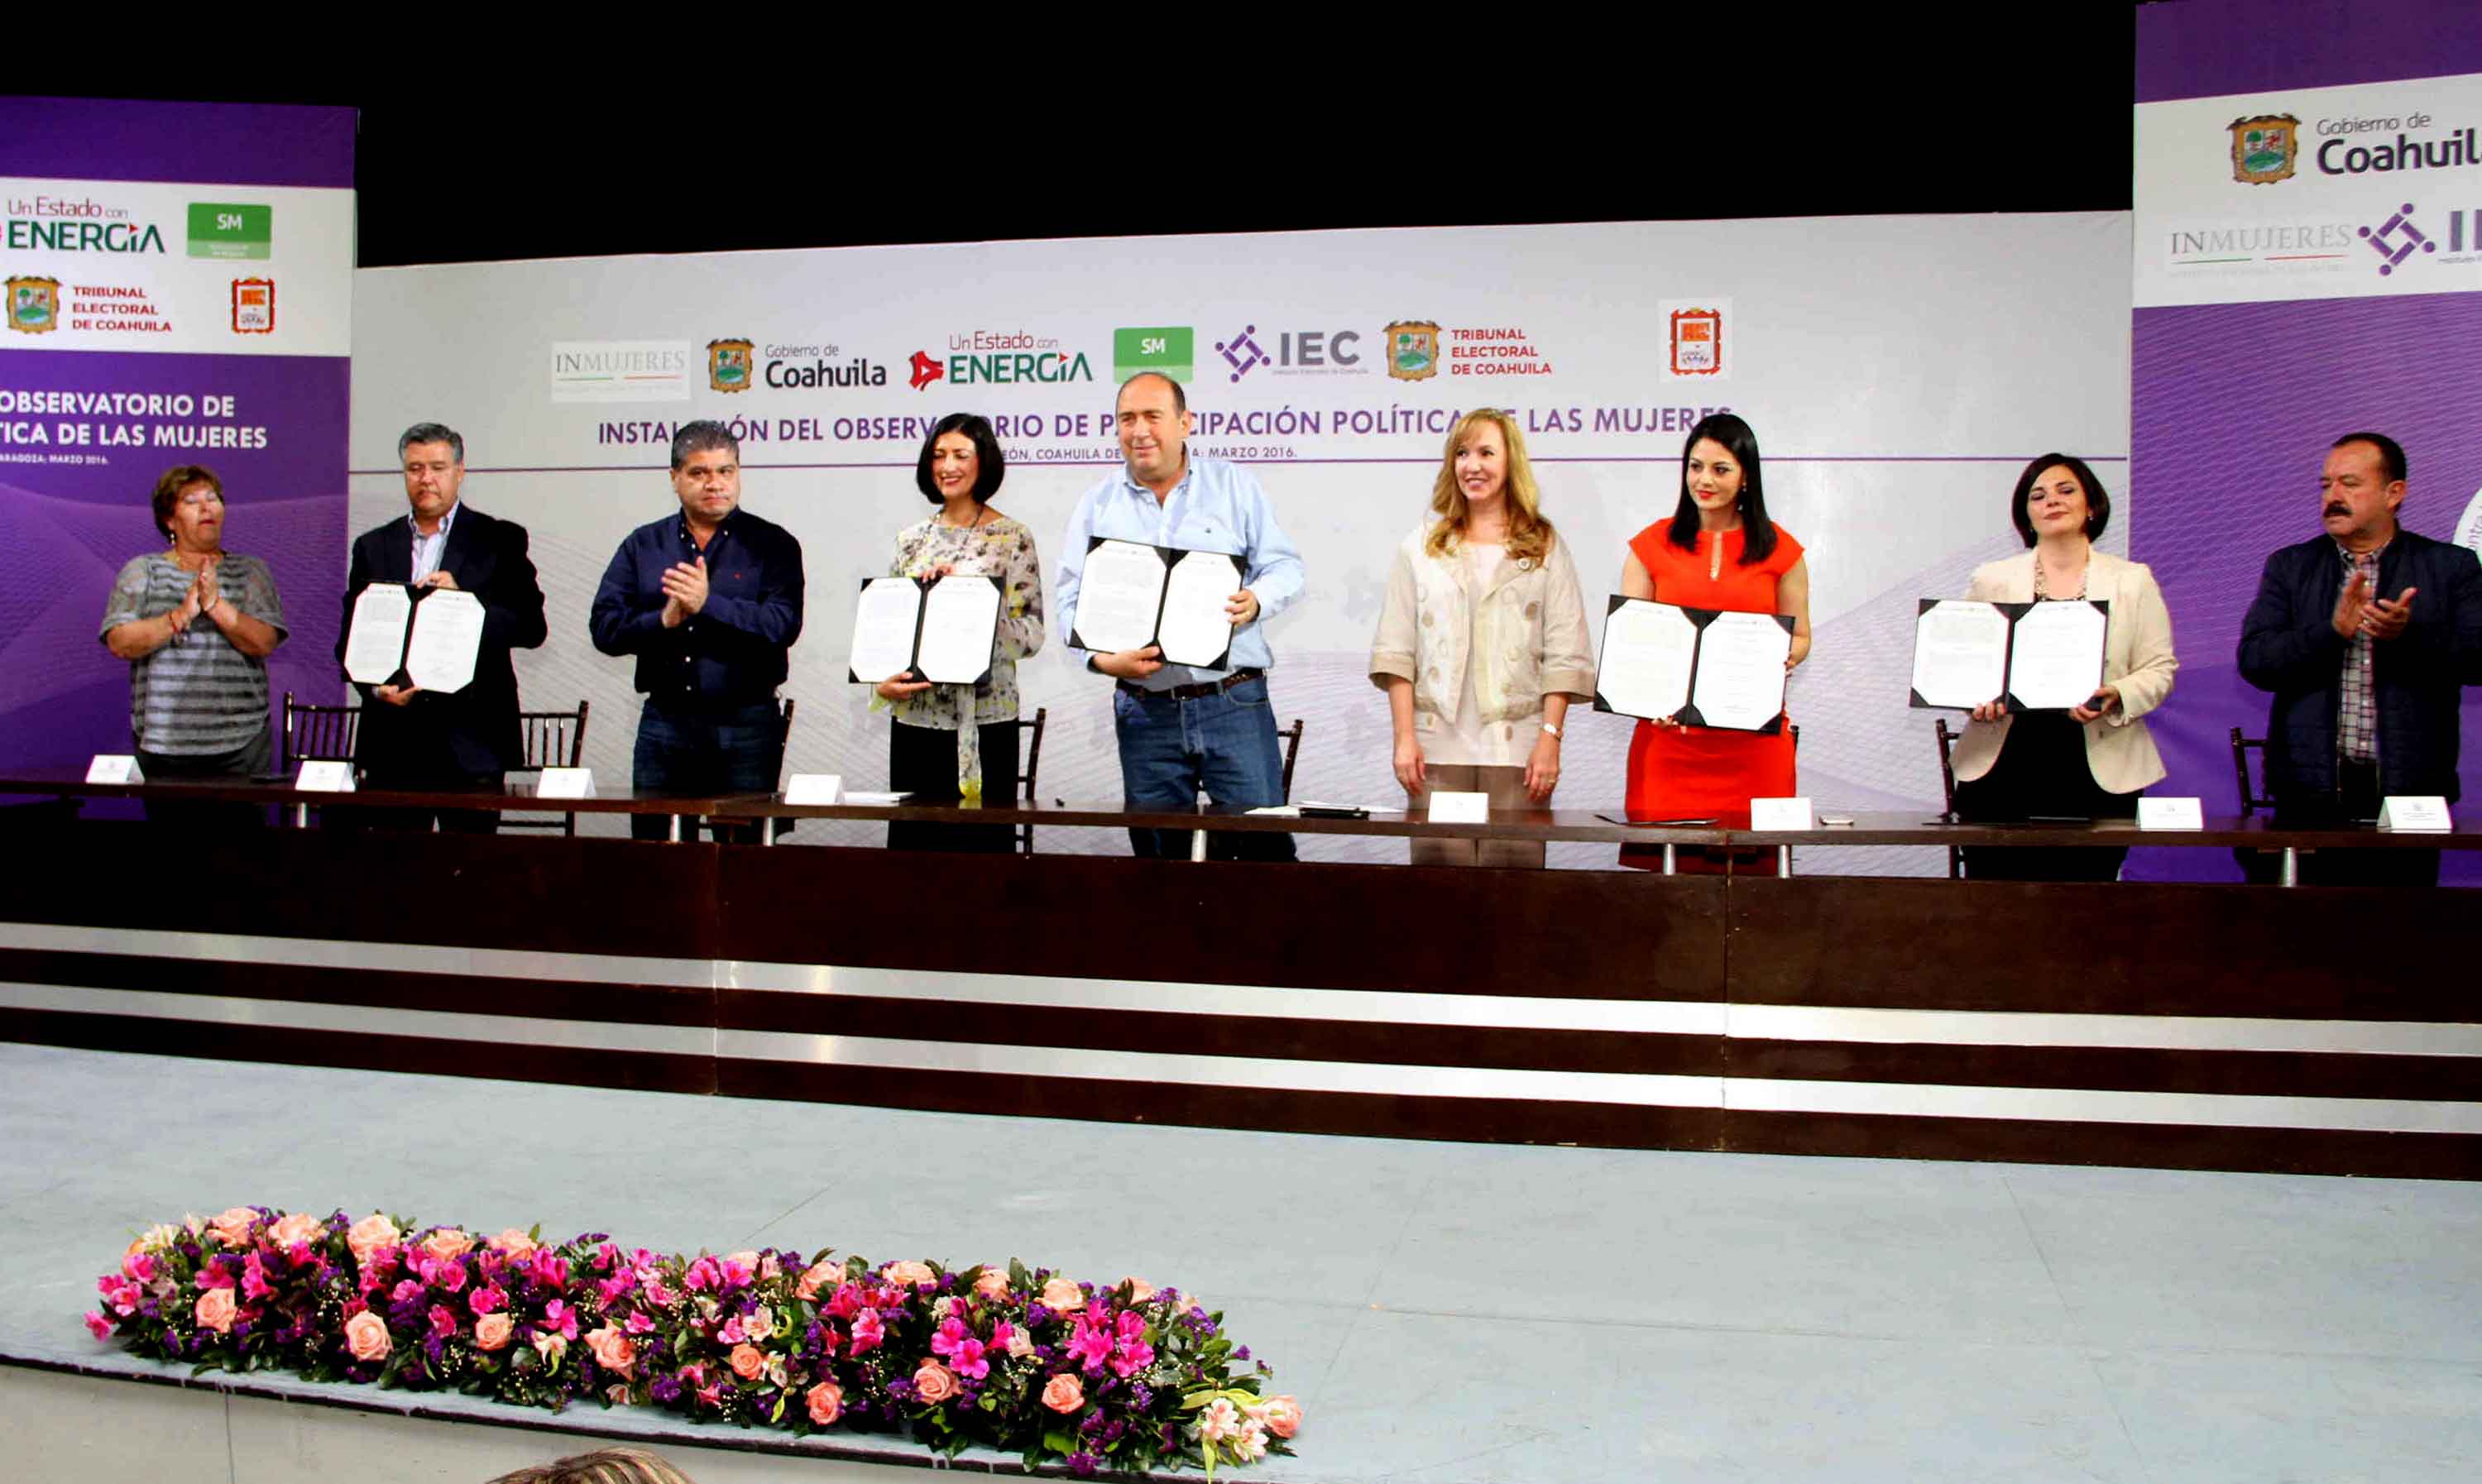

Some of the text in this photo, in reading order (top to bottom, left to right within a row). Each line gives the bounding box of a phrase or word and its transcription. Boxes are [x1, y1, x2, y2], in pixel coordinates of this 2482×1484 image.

[2317, 112, 2432, 136] Gobierno de
[2317, 128, 2482, 176] Coahuil
[8, 196, 128, 218] Un Estado con
[217, 213, 242, 231] SM
[74, 286, 146, 299] TRIBUNAL
[73, 303, 159, 315] ELECTORAL
[73, 319, 172, 333] DE COAHUILA
[1451, 328, 1526, 341] TRIBUNAL
[949, 328, 1058, 351] Un Estado con
[1141, 337, 1166, 355] SM
[1280, 331, 1360, 366] IEC
[765, 343, 839, 358] Gobierno de
[1451, 346, 1539, 358] ELECTORAL
[765, 358, 887, 390] Coahuila
[1451, 362, 1551, 376] DE COAHUILA
[203, 395, 234, 417] DE
[779, 419, 824, 442] DEL
[1055, 414, 1089, 438] DE
[1529, 409, 1582, 433] LAS
[58, 423, 92, 446] DE
[99, 424, 146, 447] LAS
[154, 425, 267, 449] MUJERES
[1036, 448, 1100, 460] COAHUILA
[1209, 447, 1258, 457] MARZO
